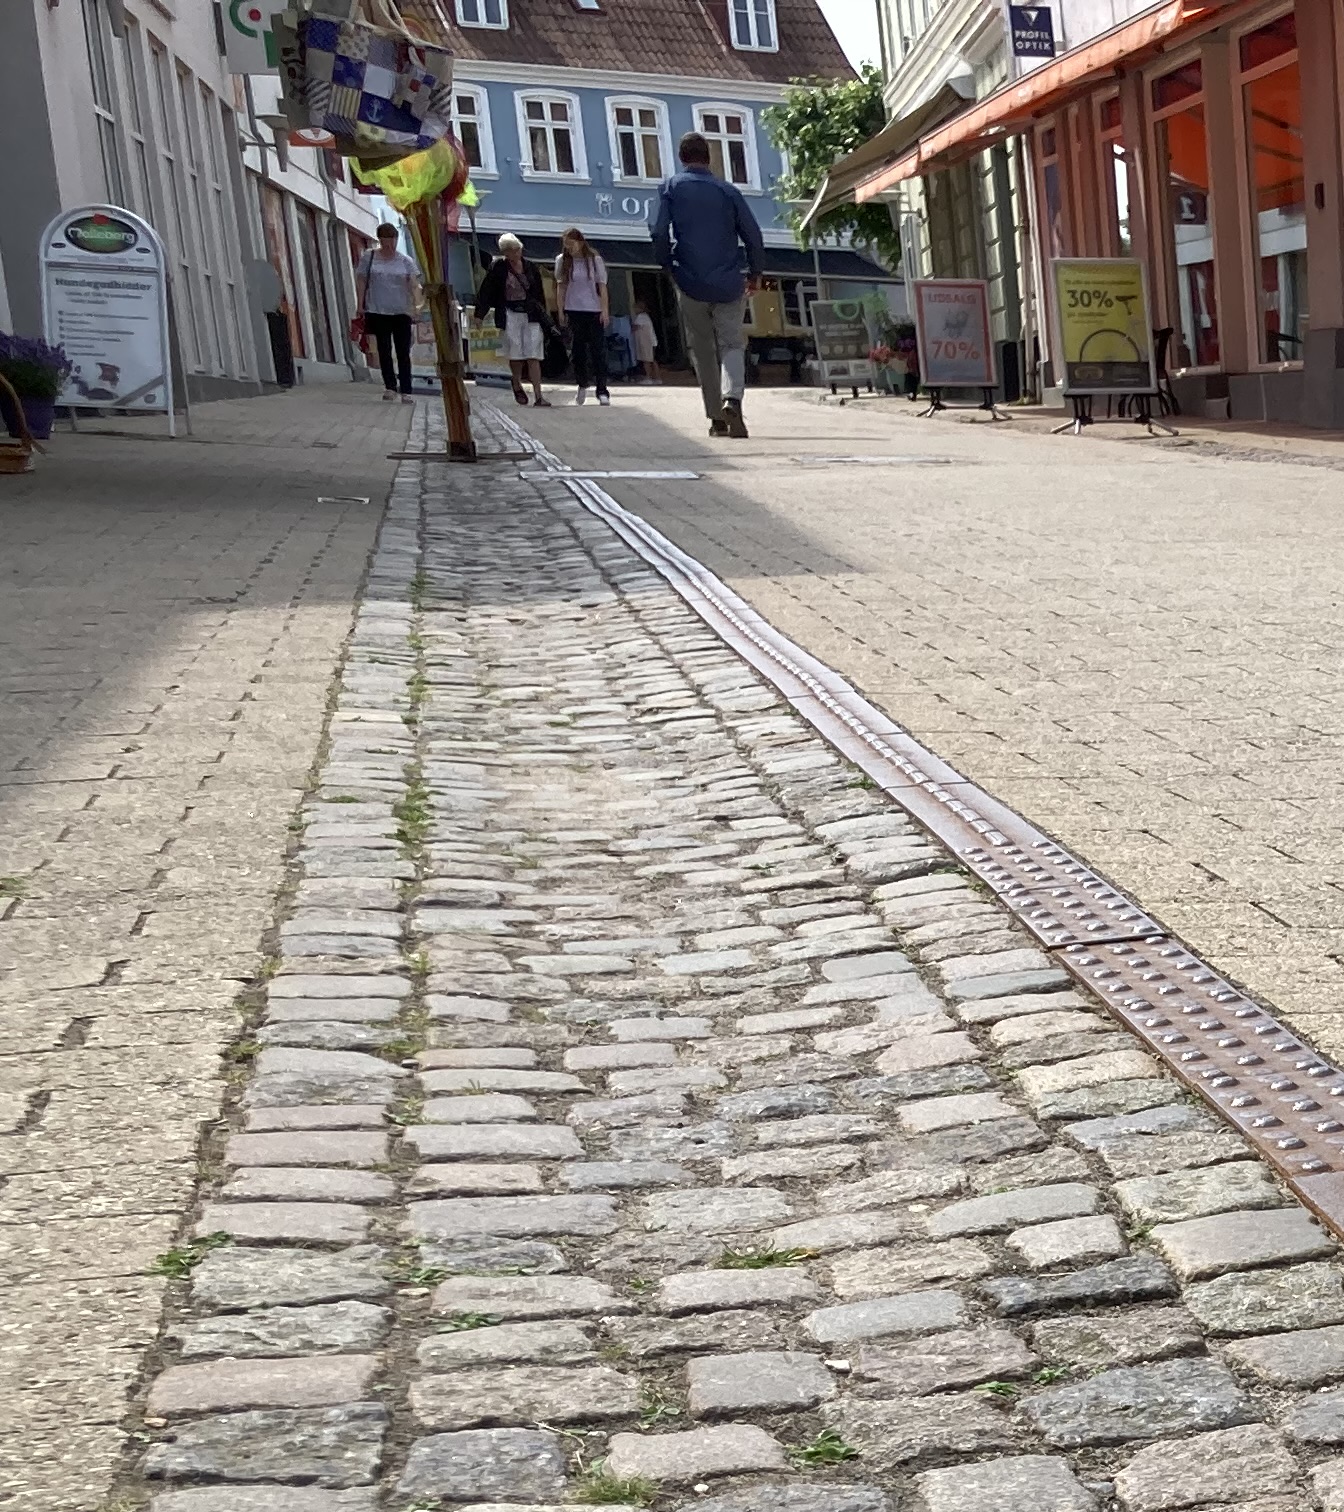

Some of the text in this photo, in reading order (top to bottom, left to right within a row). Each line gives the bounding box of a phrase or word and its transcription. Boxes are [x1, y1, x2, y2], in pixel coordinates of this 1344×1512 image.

[1015, 30, 1050, 39] PROFIL
[1015, 41, 1051, 50] OPTIK
[1067, 289, 1115, 308] 30%
[931, 340, 981, 360] 70%
